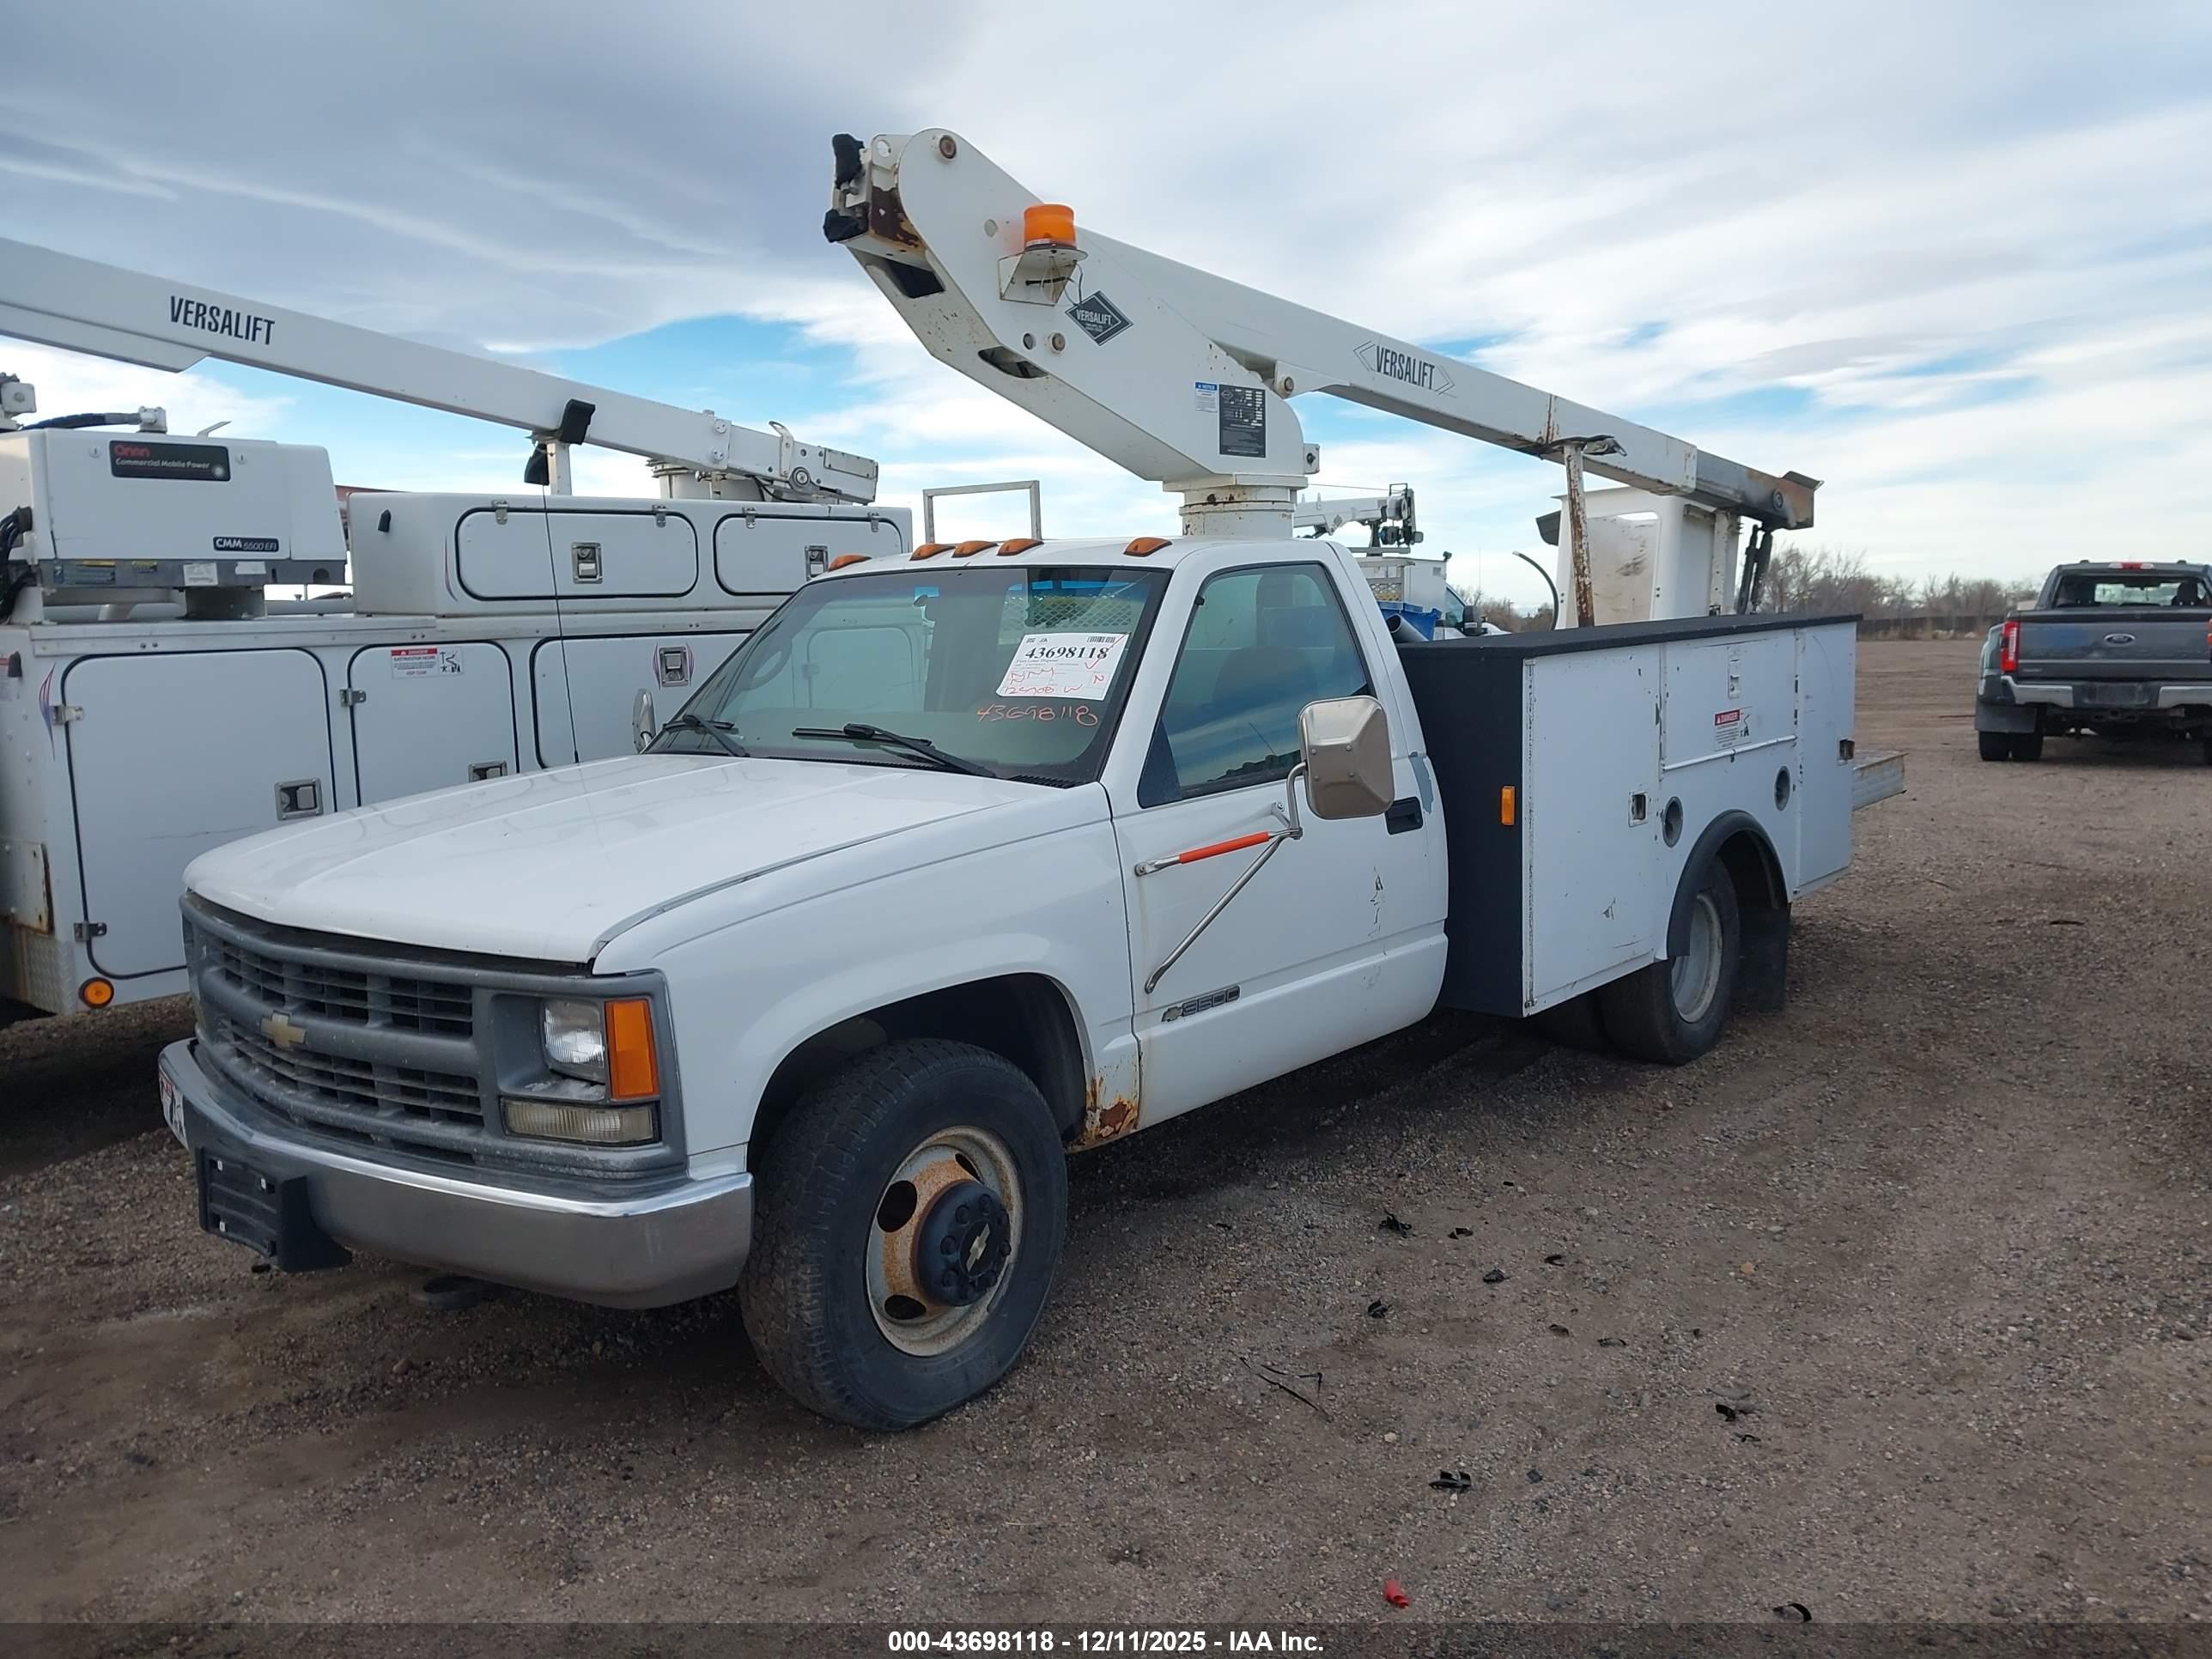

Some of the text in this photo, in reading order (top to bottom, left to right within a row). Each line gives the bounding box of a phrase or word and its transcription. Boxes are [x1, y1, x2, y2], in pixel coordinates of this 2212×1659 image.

[170, 295, 275, 345] VERSALIFT
[1076, 308, 1113, 325] VERSALIFT
[1376, 345, 1435, 390] VERSALIFT
[115, 458, 161, 467] Commercial
[186, 461, 210, 470] Power
[216, 538, 242, 548] CMM
[1025, 646, 1109, 659] 43698118
[976, 703, 1098, 726] 43698118
